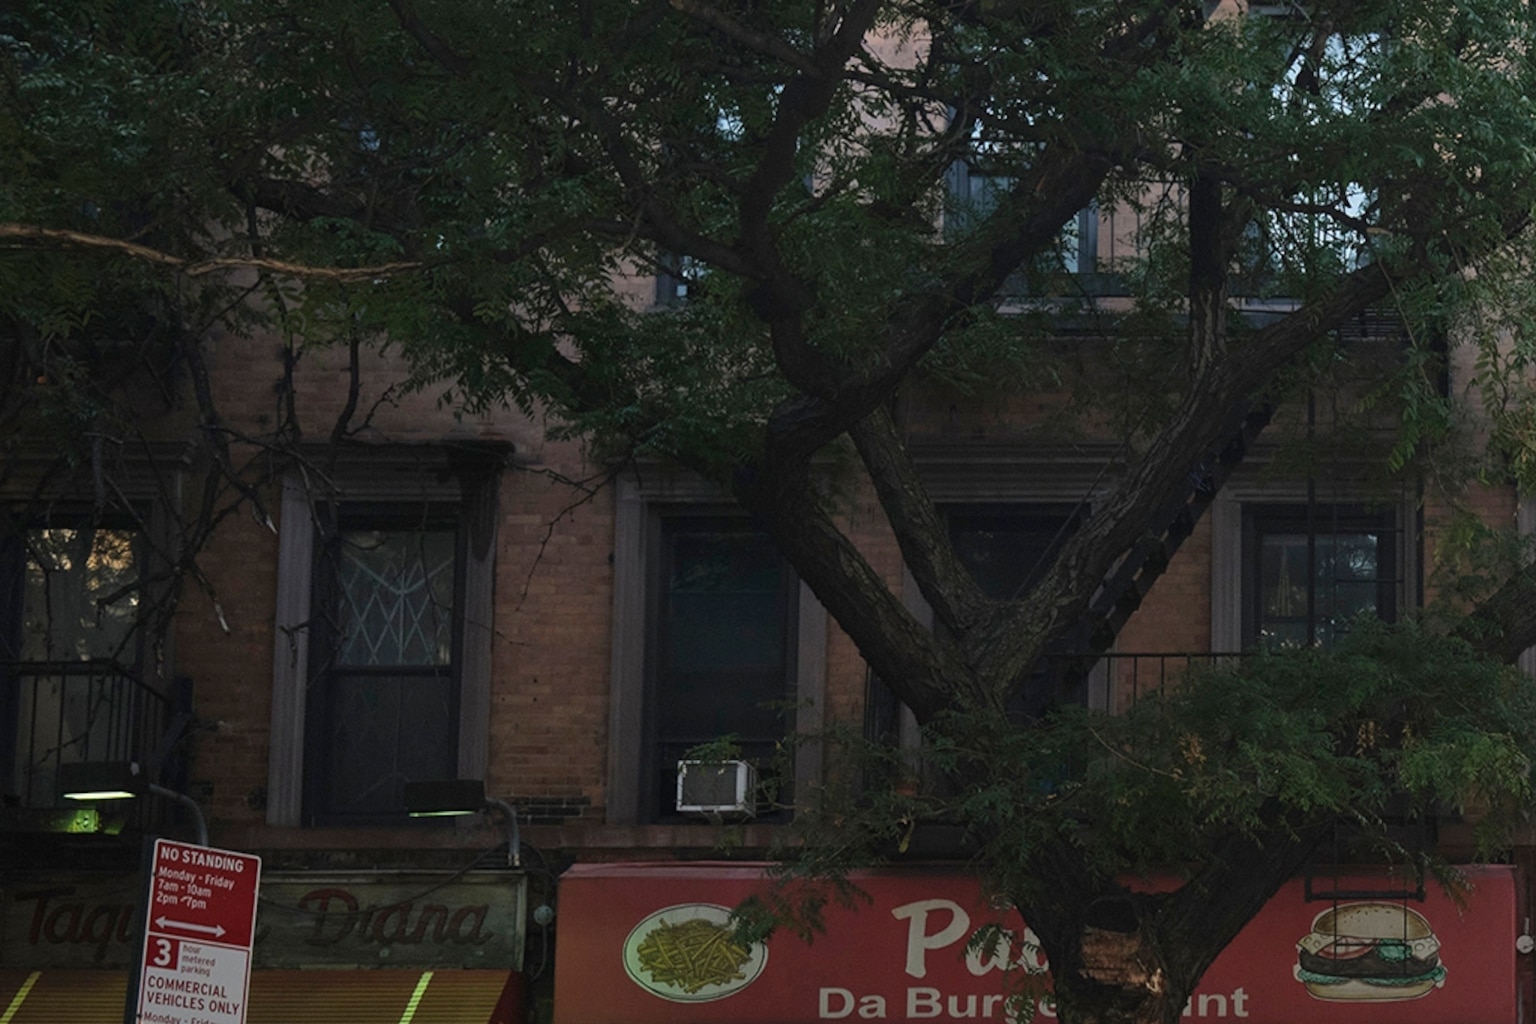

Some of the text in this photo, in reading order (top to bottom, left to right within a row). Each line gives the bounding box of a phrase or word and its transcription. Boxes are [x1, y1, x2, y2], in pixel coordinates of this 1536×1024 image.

[161, 846, 244, 873] NO STANDING
[158, 866, 235, 891] Monday Friday
[158, 879, 212, 897] 7am 10am
[157, 892, 207, 910] 2pm 7pm
[301, 887, 494, 949] Diana
[154, 939, 172, 966] 3
[182, 945, 202, 955] hour
[182, 954, 216, 967] metered
[181, 966, 210, 978] parking
[147, 975, 228, 998] COMMERCIAL
[147, 991, 240, 1015] VEHICLES ONLY
[818, 987, 887, 1019] Da
[1181, 986, 1249, 1018] int
